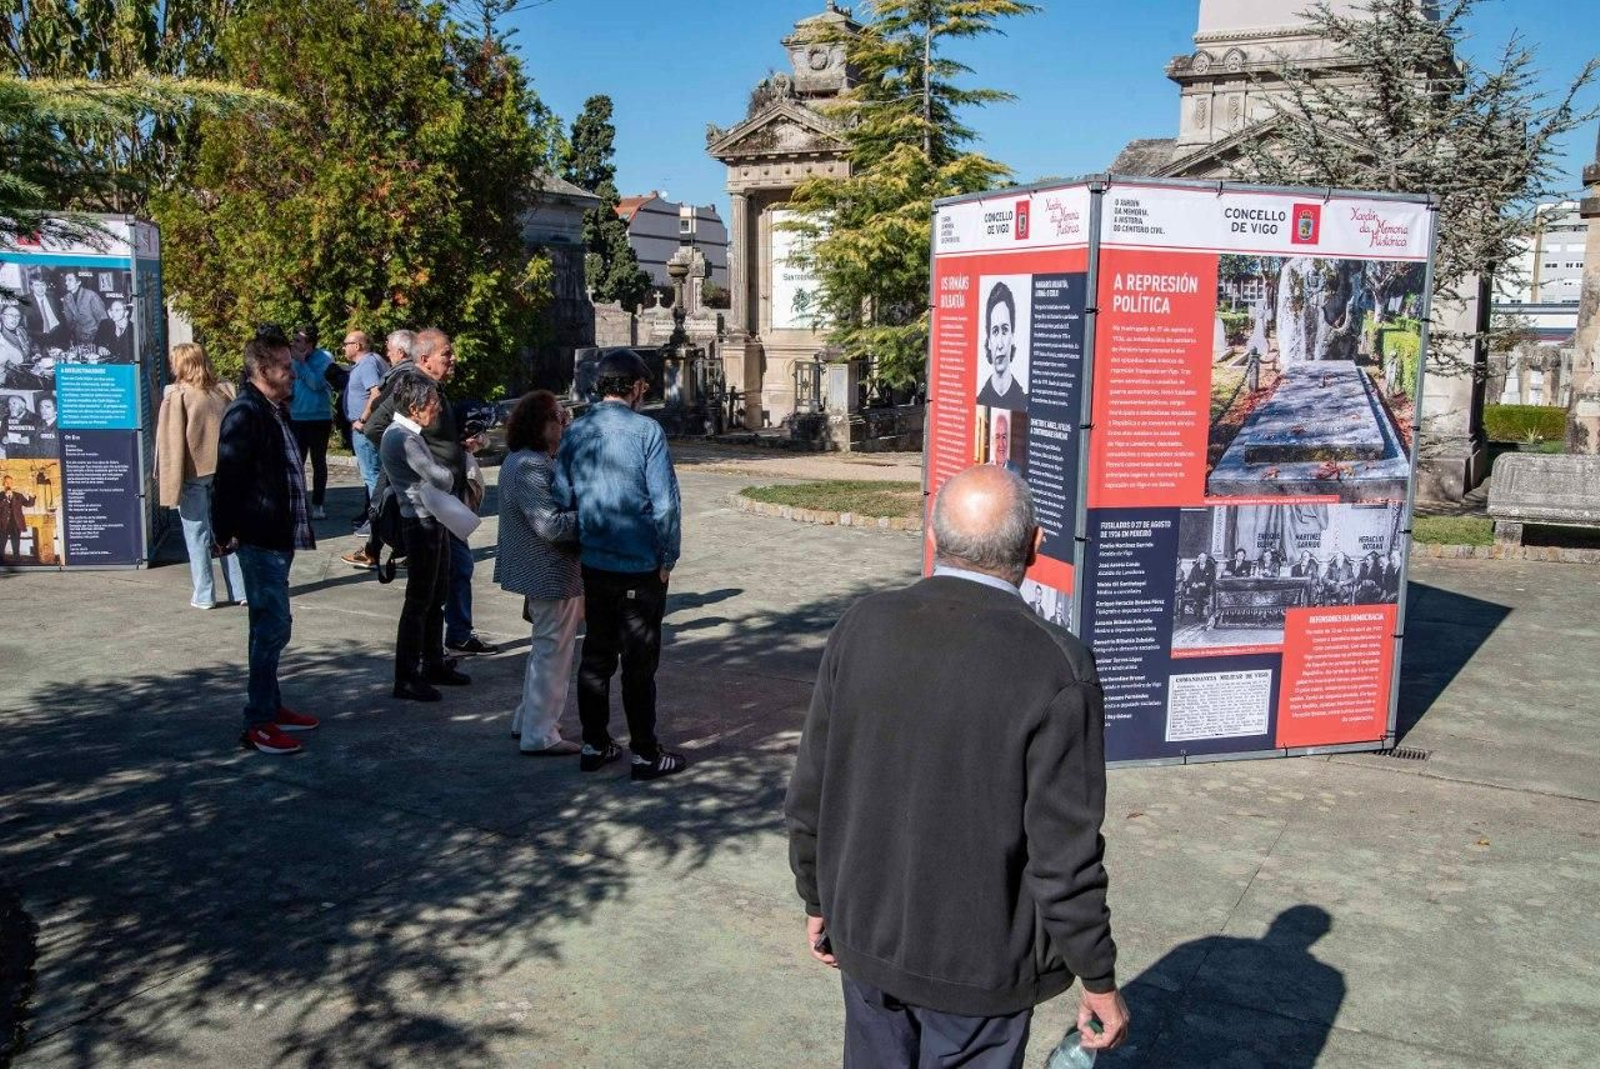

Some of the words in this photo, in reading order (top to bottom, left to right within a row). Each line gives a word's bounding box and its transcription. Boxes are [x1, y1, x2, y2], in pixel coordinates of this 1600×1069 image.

[984, 210, 1013, 223] CONCELLO
[1224, 207, 1286, 222] CONCELLO
[987, 225, 995, 235] DE
[996, 223, 1010, 234] VIGO
[1231, 221, 1248, 233] DE
[1249, 223, 1278, 235] VIGO
[1114, 274, 1123, 290] A
[1126, 271, 1198, 293] REPRESIÓN
[1113, 293, 1171, 315] POLÍTICA
